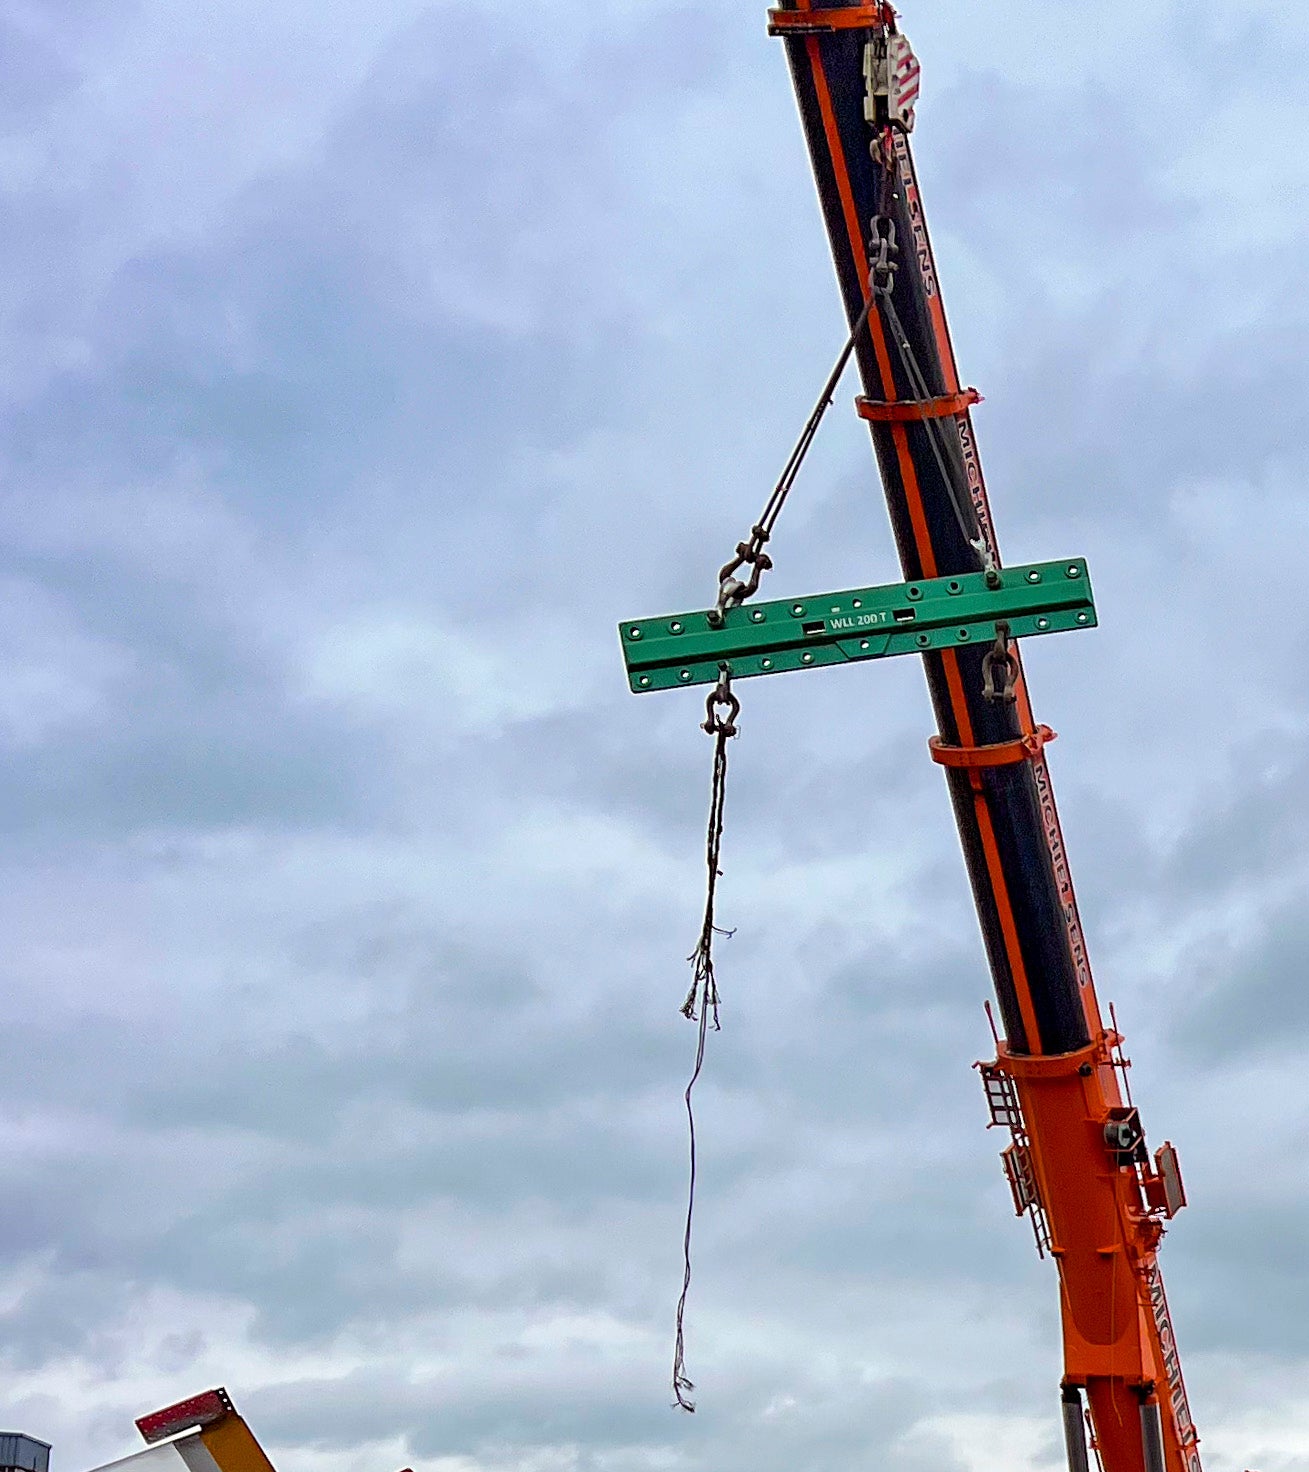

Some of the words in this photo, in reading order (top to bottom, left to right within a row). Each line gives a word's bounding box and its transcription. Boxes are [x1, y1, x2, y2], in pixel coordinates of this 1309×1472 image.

[830, 617, 855, 629] WLL
[856, 613, 878, 626] 200
[879, 612, 887, 622] T
